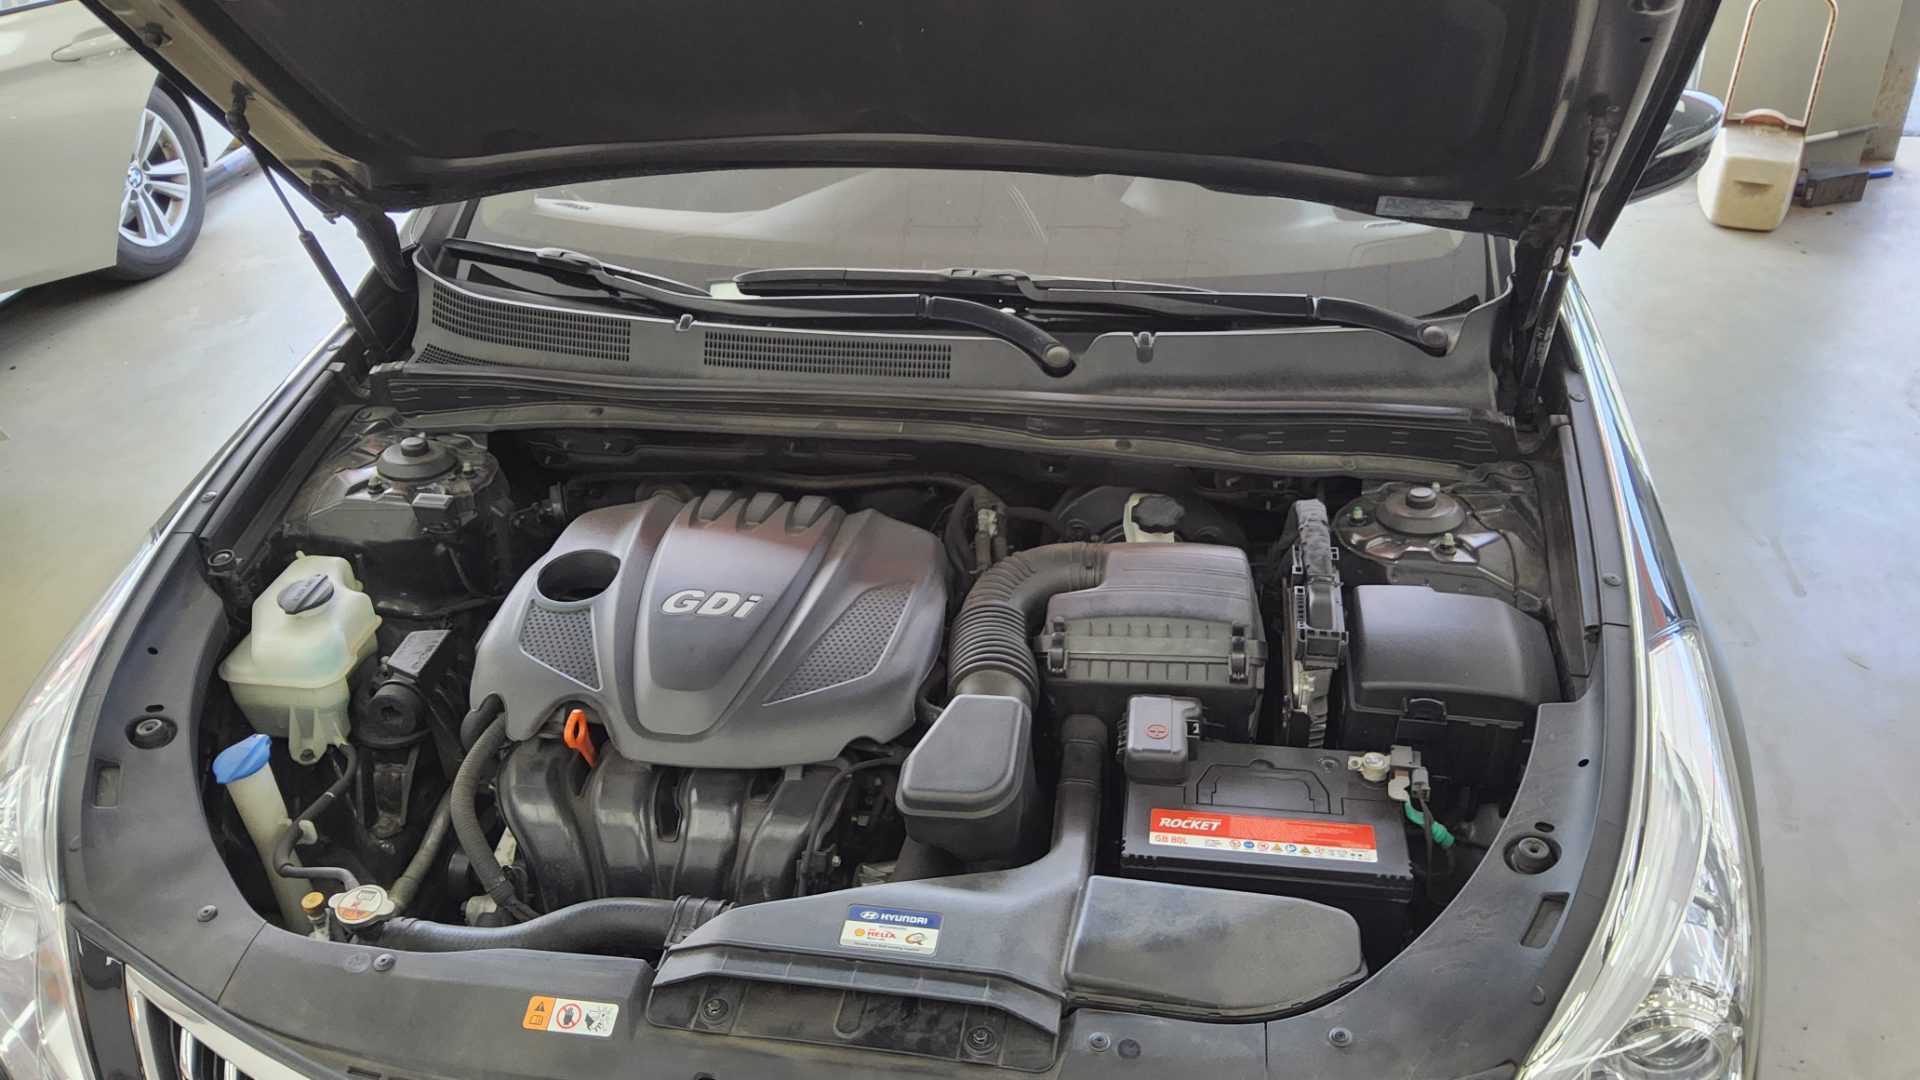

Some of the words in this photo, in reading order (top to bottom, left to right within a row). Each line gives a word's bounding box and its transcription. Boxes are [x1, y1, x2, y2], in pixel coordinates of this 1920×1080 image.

[661, 589, 762, 618] GDi
[1159, 817, 1221, 831] ROCKET
[1155, 834, 1169, 842] GB
[880, 912, 928, 925] HYUNDAI
[867, 931, 896, 939] HELIX
